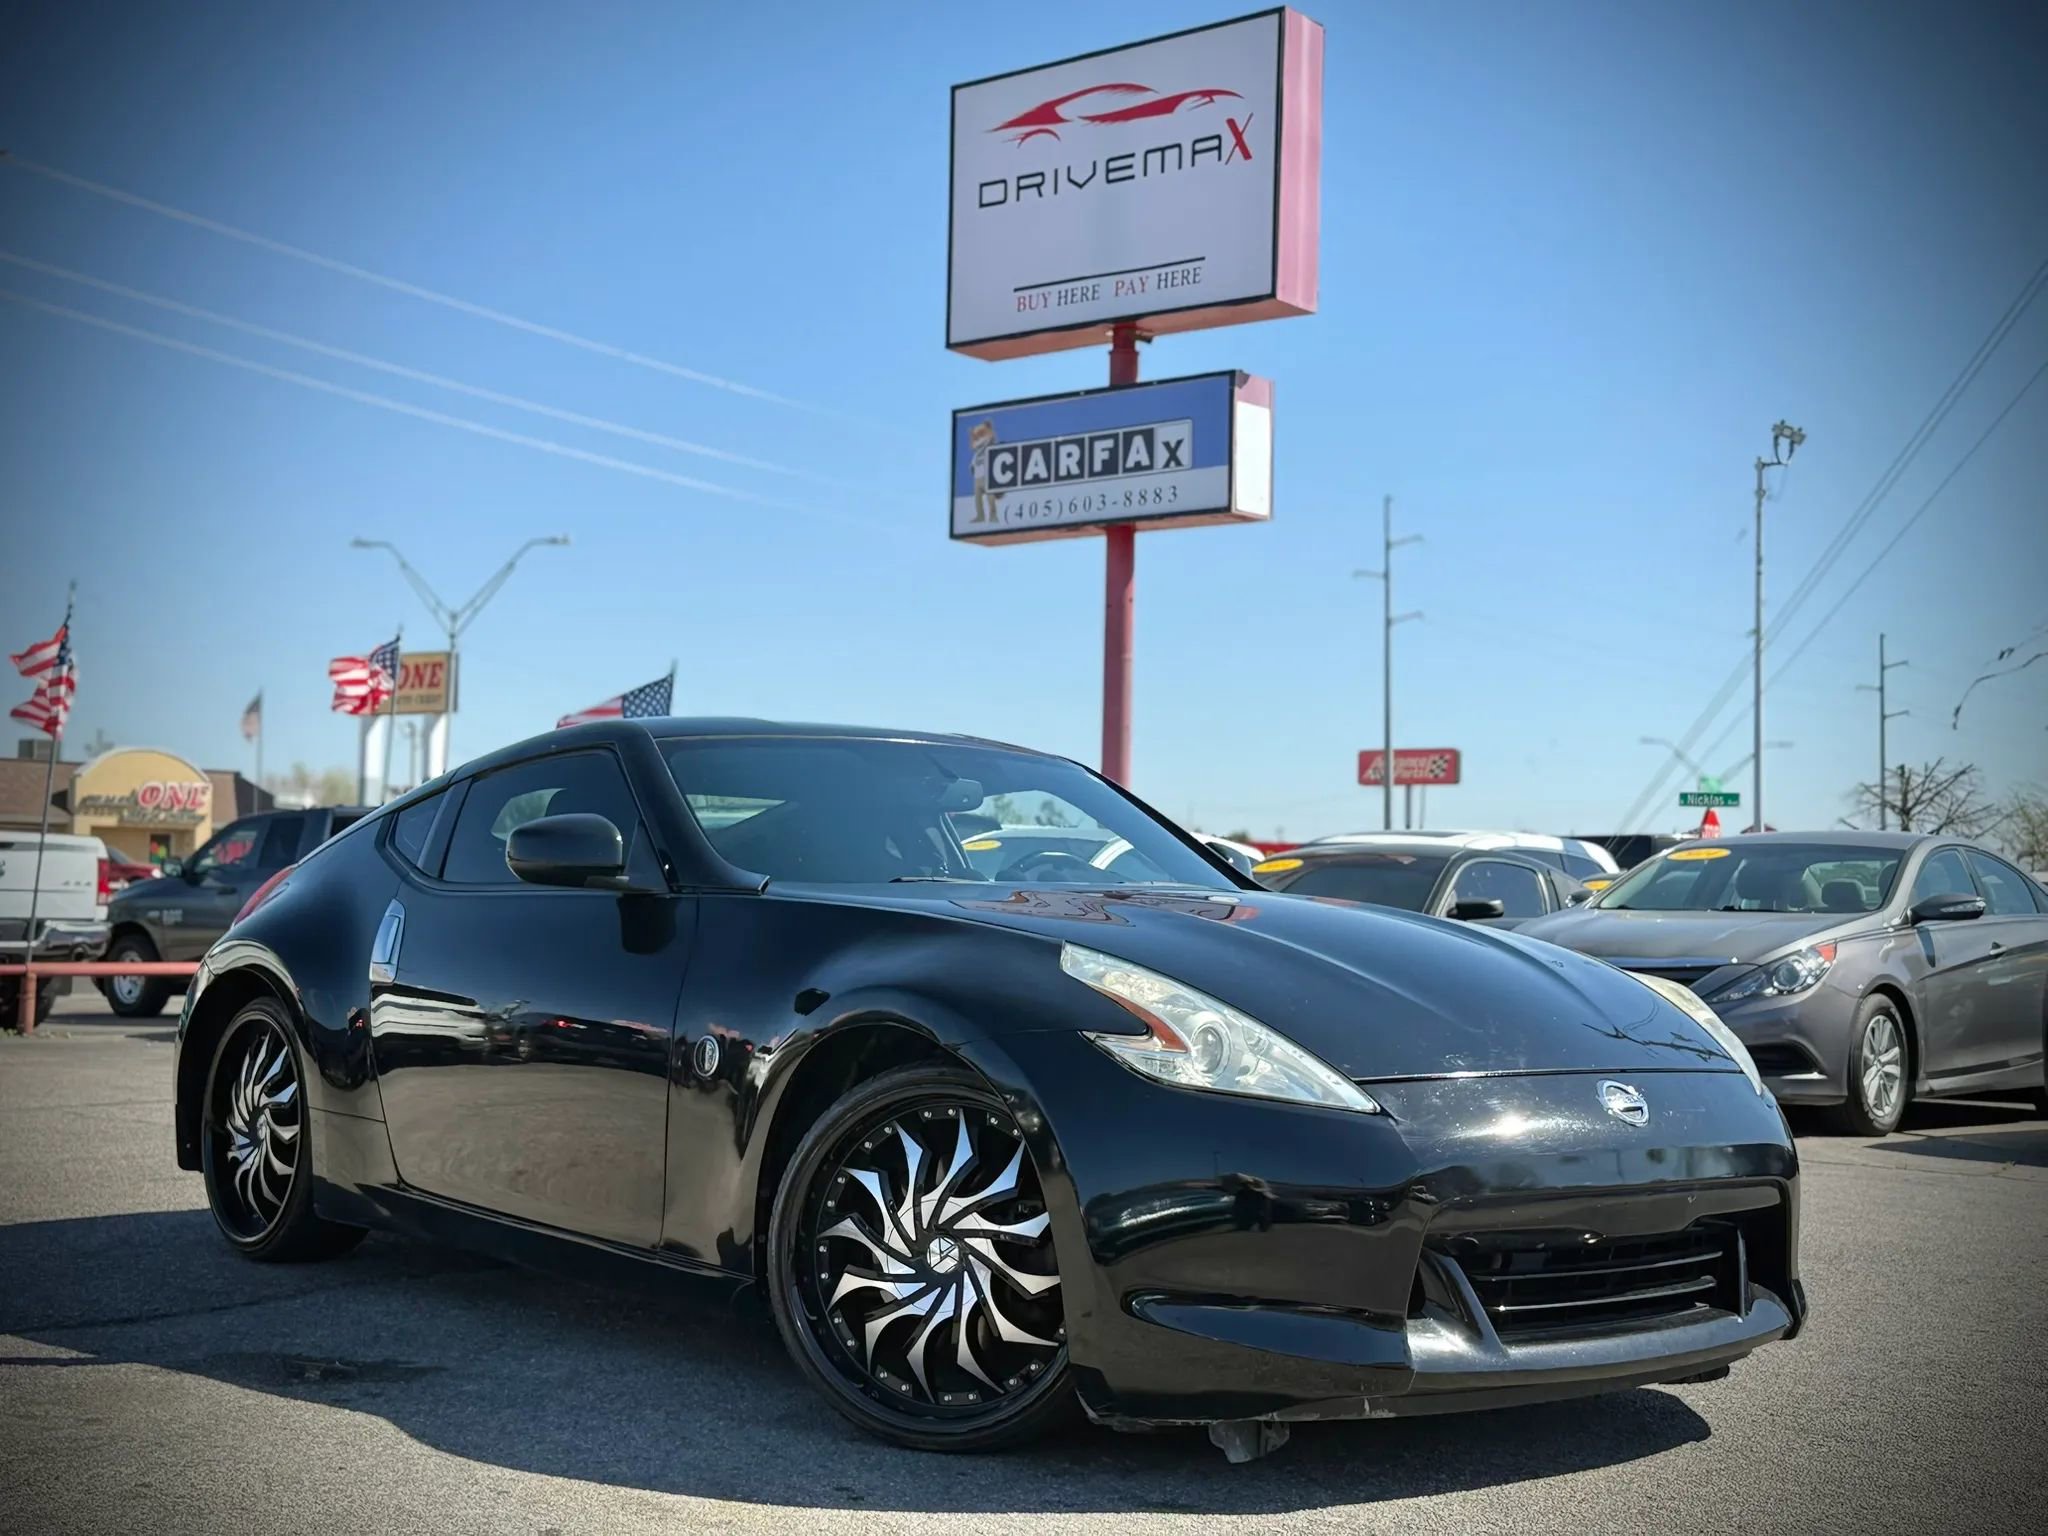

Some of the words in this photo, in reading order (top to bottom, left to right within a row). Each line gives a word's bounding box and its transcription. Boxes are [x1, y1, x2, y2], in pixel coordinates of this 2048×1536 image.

[978, 112, 1254, 209] DRIVEMAX
[1016, 291, 1052, 313] BUY
[1057, 284, 1101, 306] HERE
[1114, 276, 1149, 297] PAY
[1157, 266, 1202, 289] HERE
[992, 434, 1184, 485] CARFAX
[1003, 484, 1179, 524] (405)603-8883
[138, 783, 210, 809] ONE
